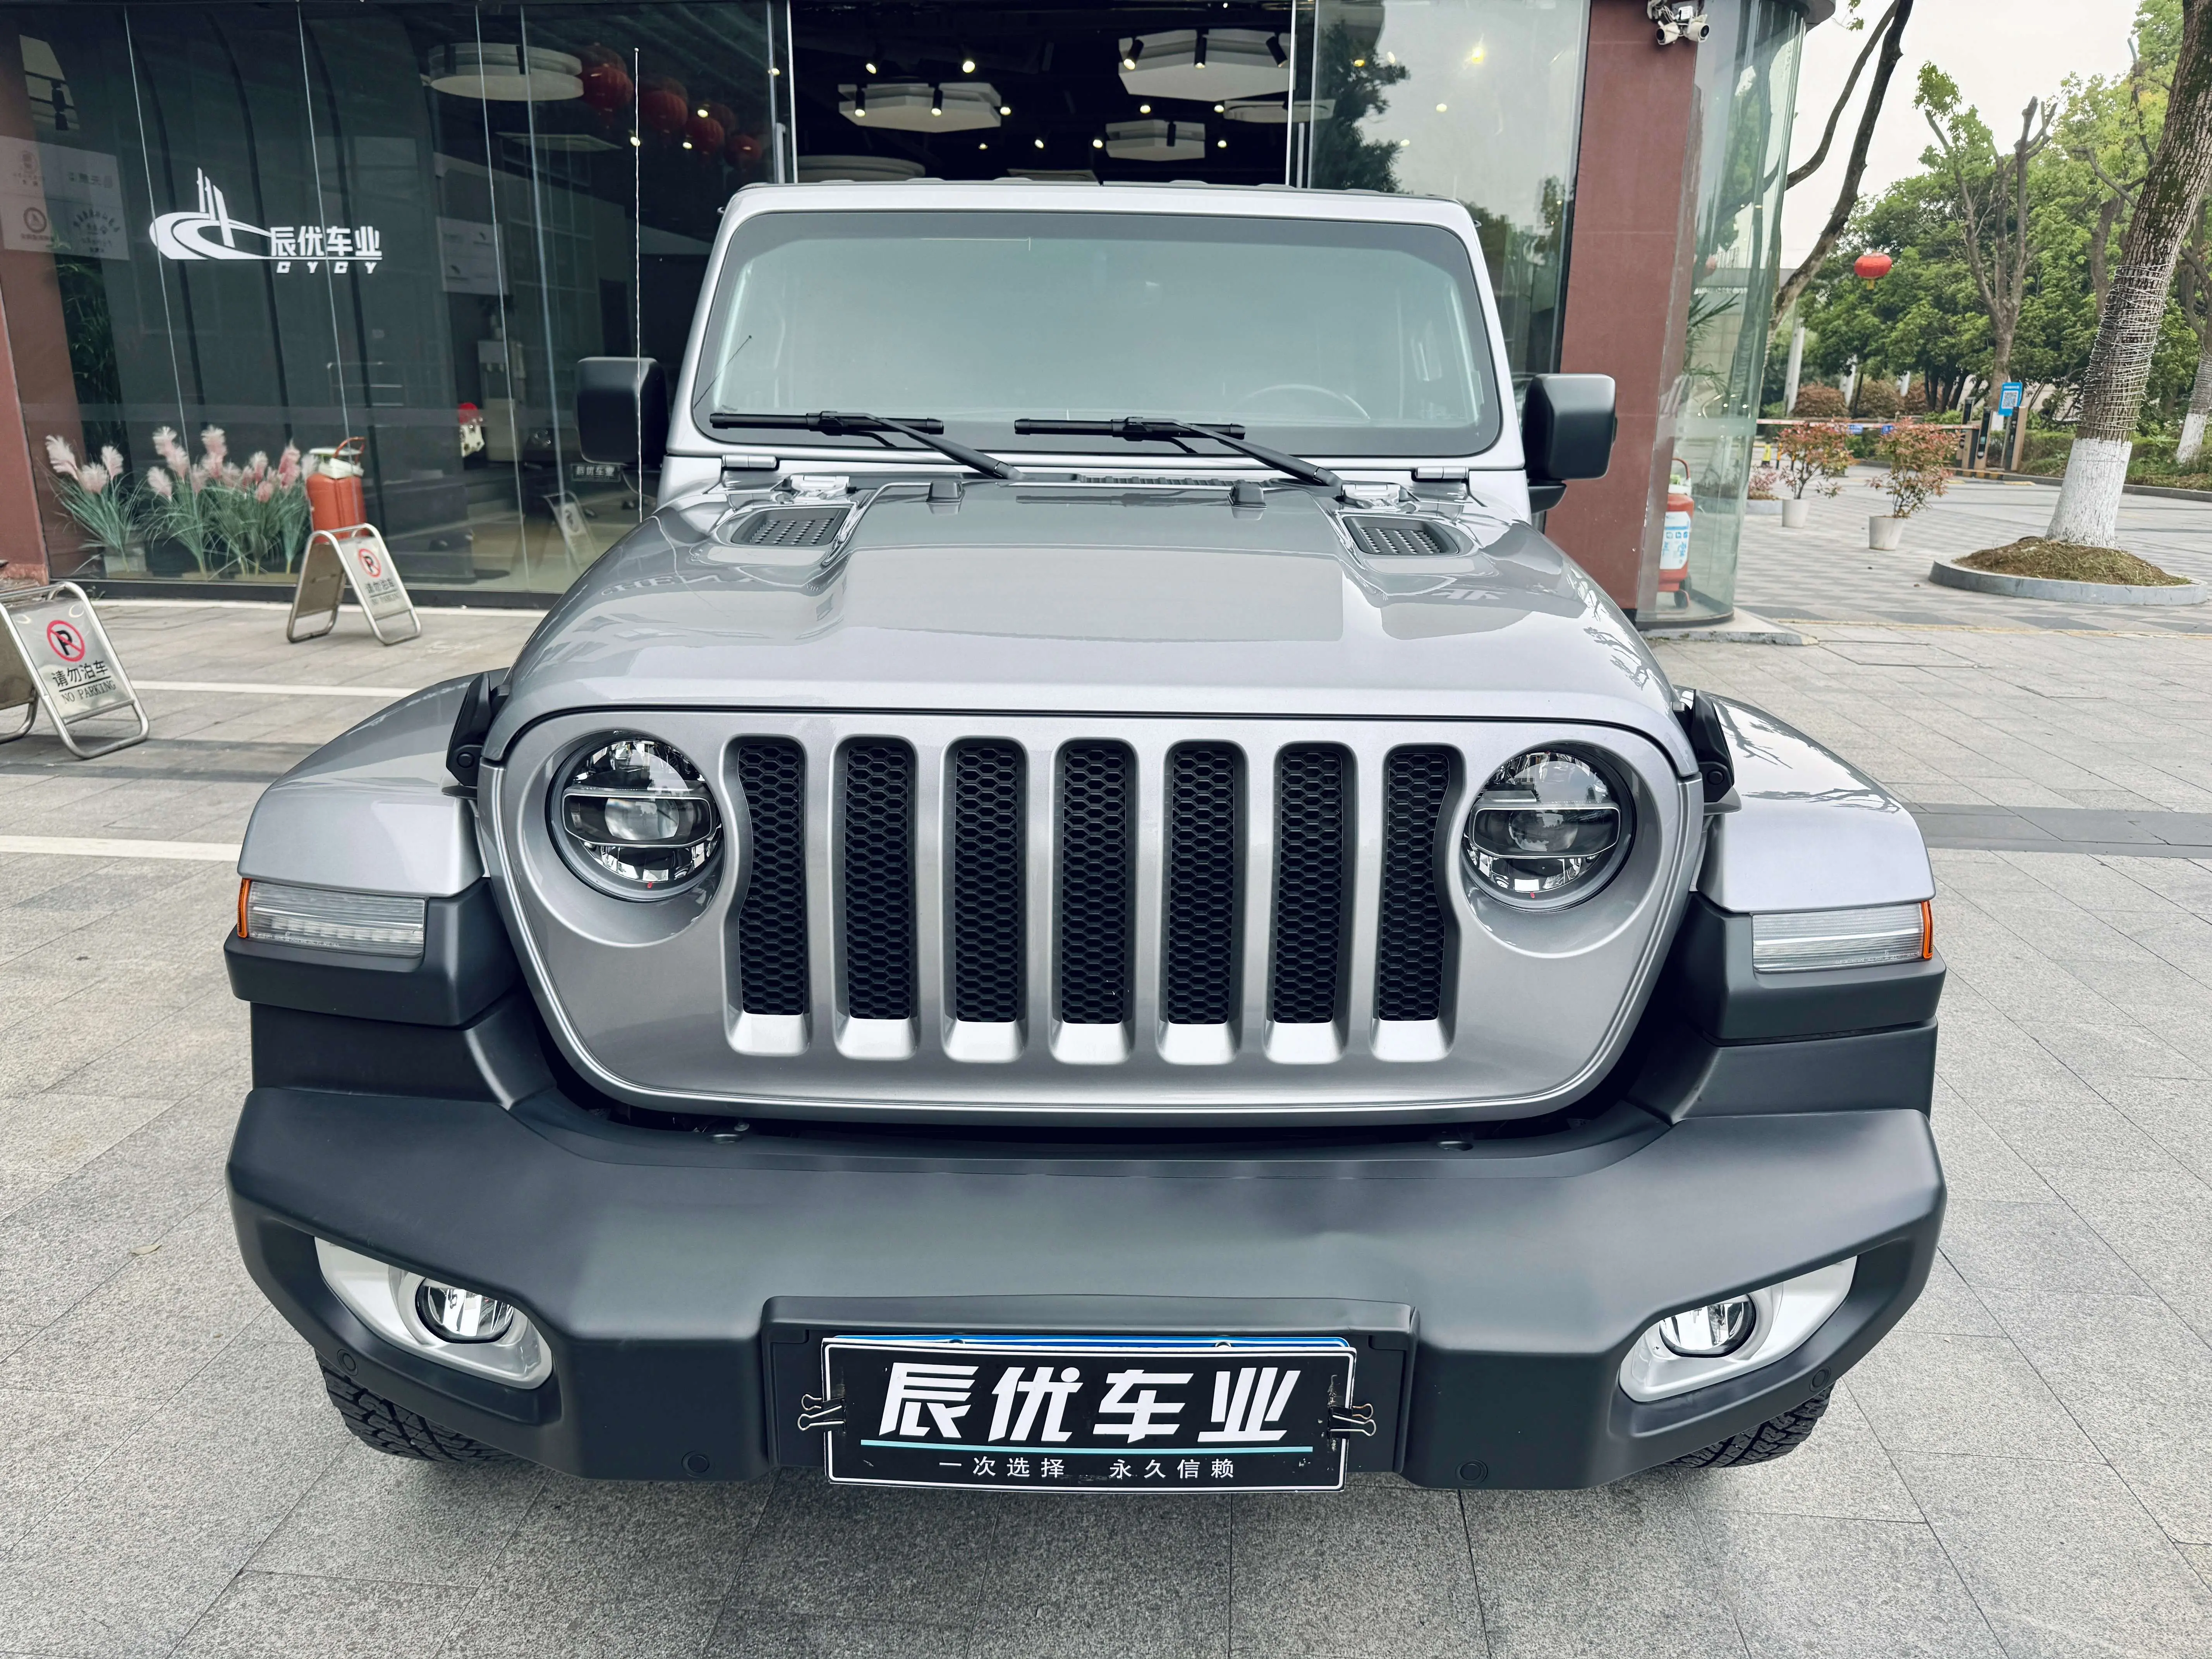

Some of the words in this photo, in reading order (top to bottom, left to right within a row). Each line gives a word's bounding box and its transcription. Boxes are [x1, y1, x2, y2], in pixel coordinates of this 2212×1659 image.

[270, 226, 382, 256] 辰优车业
[51, 659, 108, 687] 请勿泊车
[61, 691, 76, 704] NO
[78, 680, 116, 700] PARKING
[879, 1362, 1301, 1443] 辰优车业
[939, 1456, 1065, 1478] 一次选择
[1109, 1459, 1234, 1479] 永久信赖
